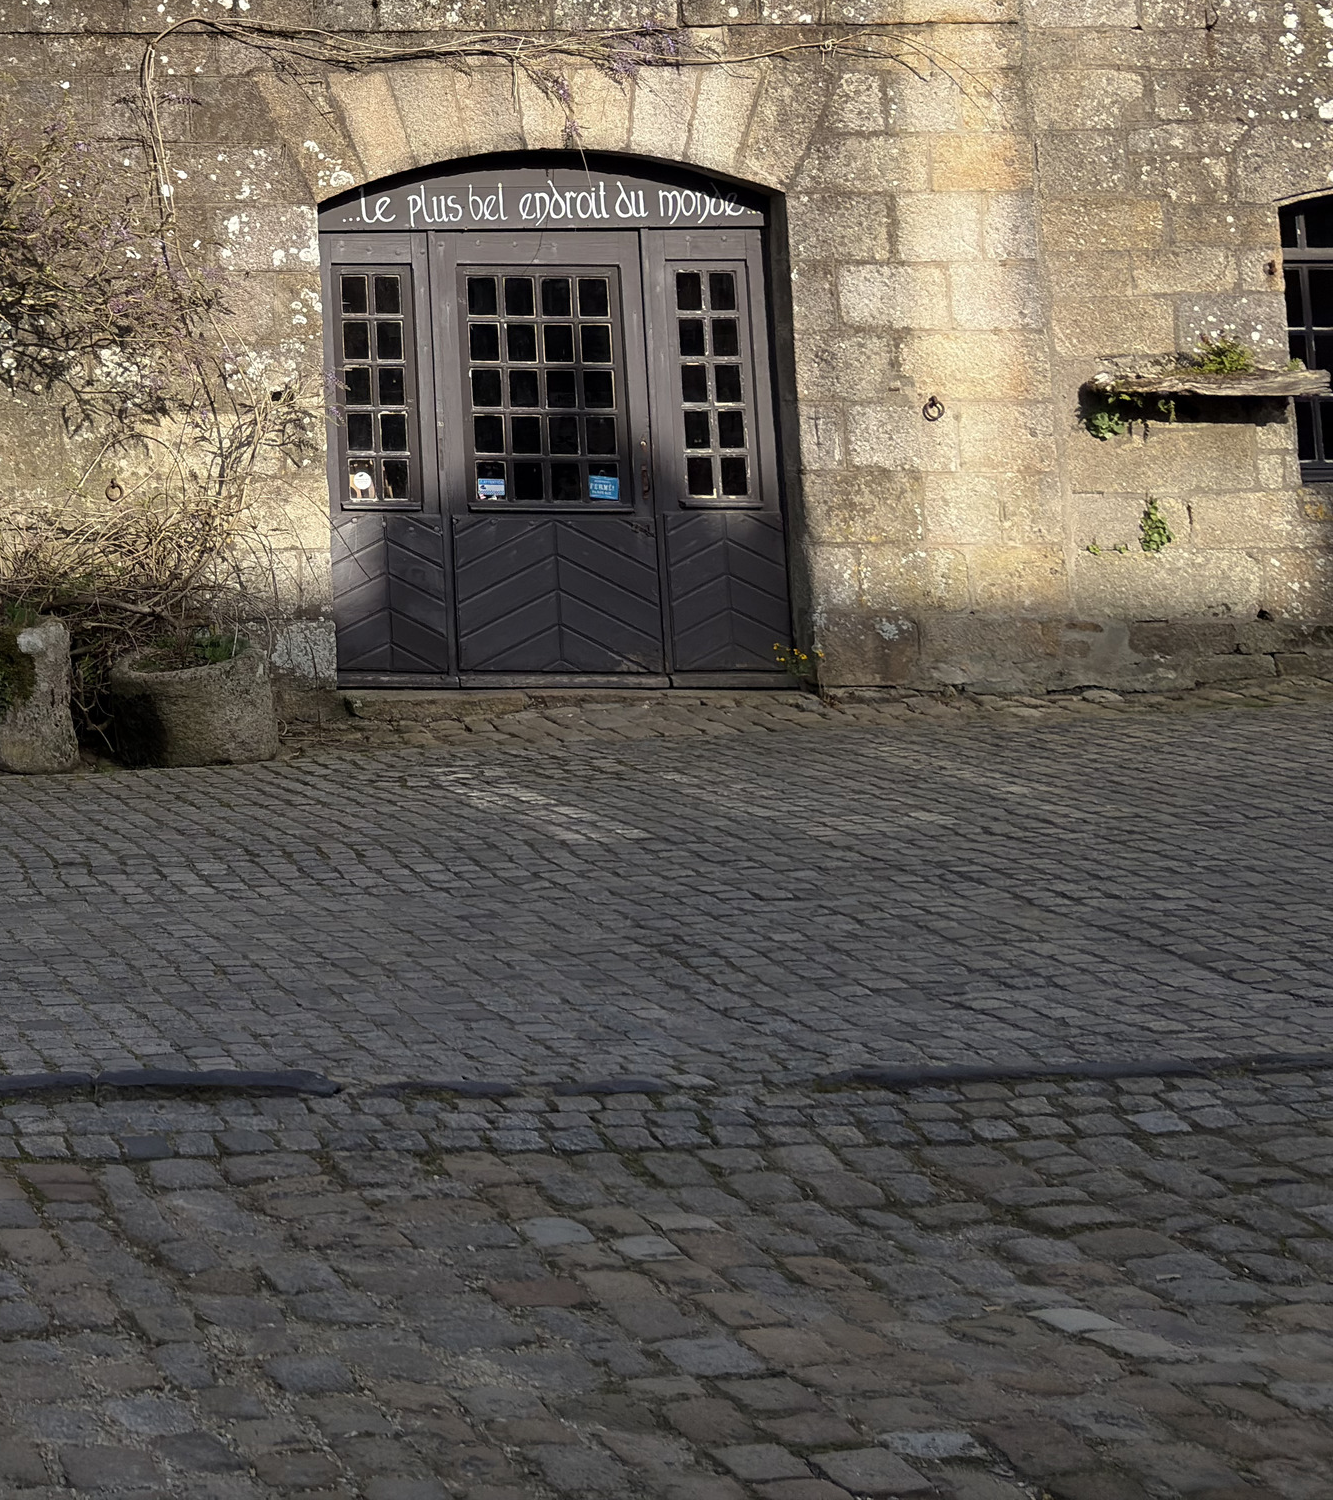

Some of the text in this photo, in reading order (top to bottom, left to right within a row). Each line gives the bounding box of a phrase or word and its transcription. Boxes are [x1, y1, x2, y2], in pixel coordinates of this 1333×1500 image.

[407, 184, 462, 228] plus
[468, 182, 508, 221] bel
[518, 180, 609, 226] endroit
[615, 181, 648, 218] du
